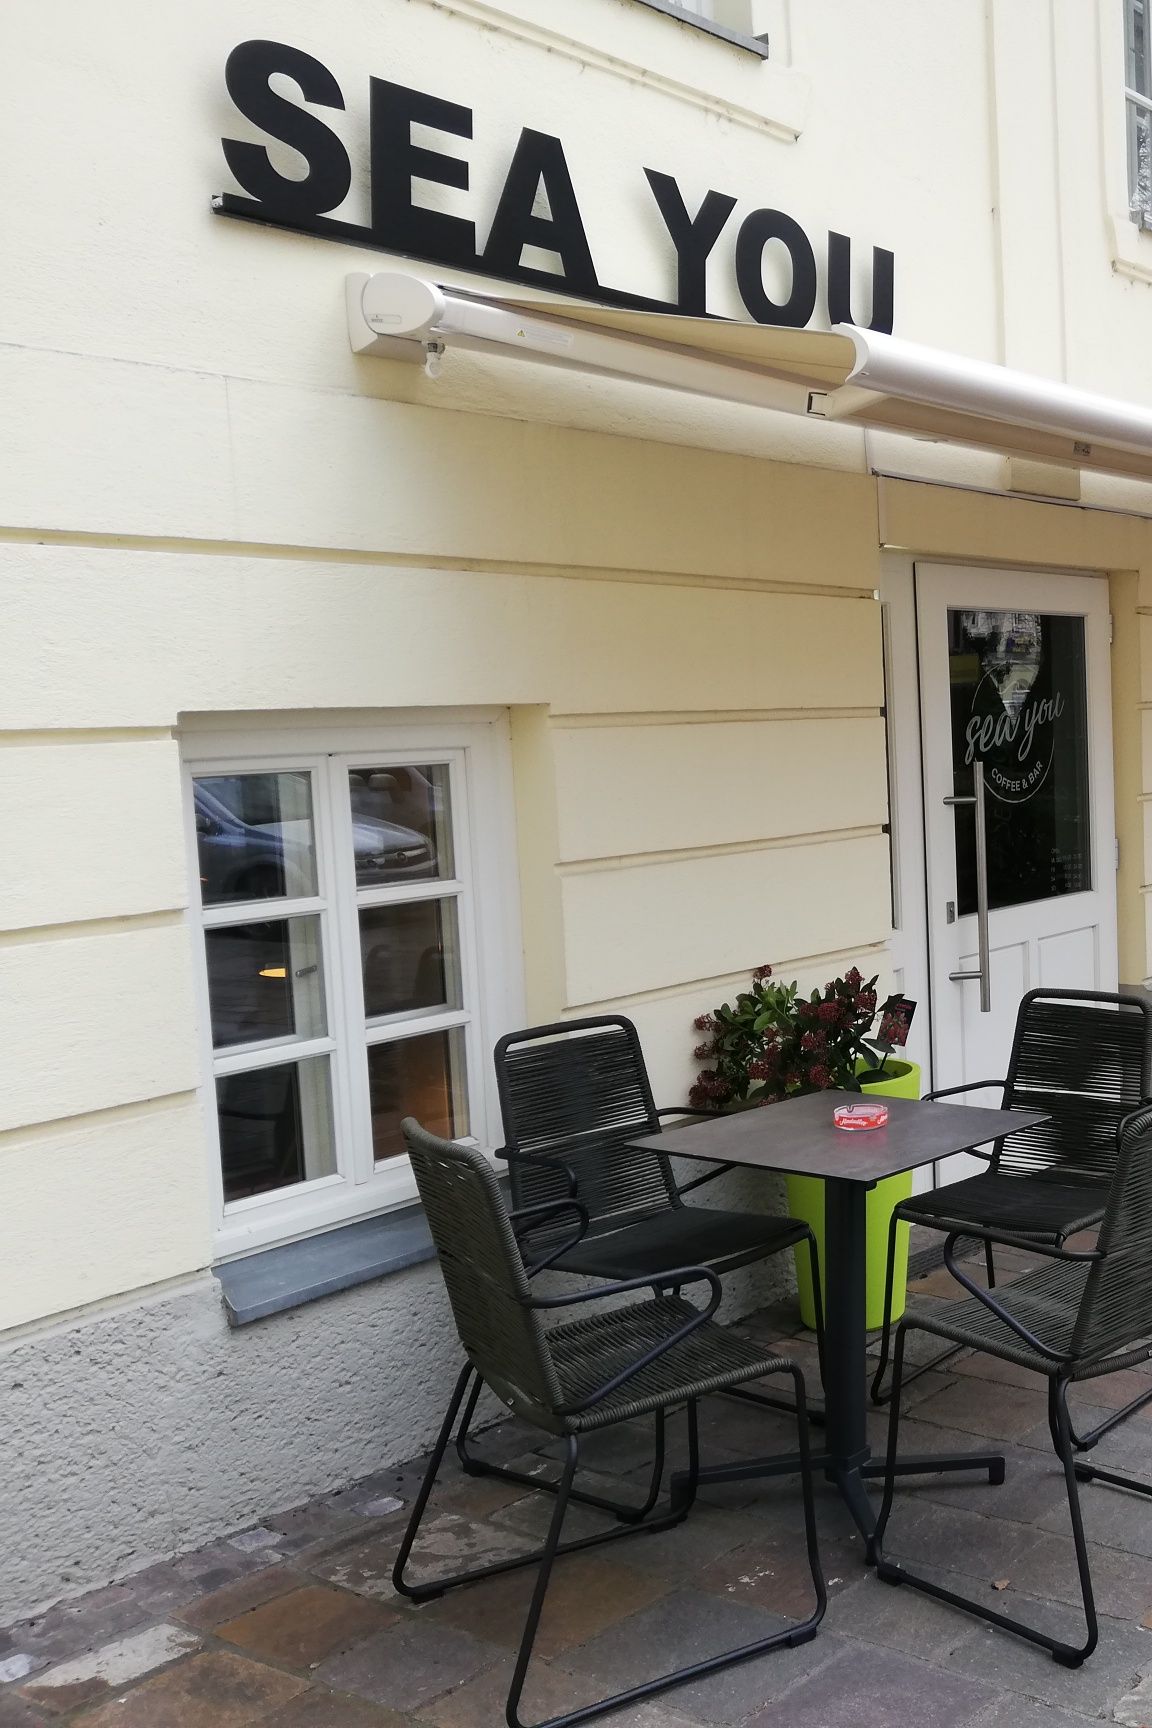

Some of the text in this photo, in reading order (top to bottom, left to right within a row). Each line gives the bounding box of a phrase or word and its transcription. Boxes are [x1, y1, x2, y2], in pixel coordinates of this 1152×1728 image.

[221, 38, 895, 335] SEA YOU
[965, 691, 1065, 766] sea you
[991, 760, 1043, 791] COFFEE & BAR
